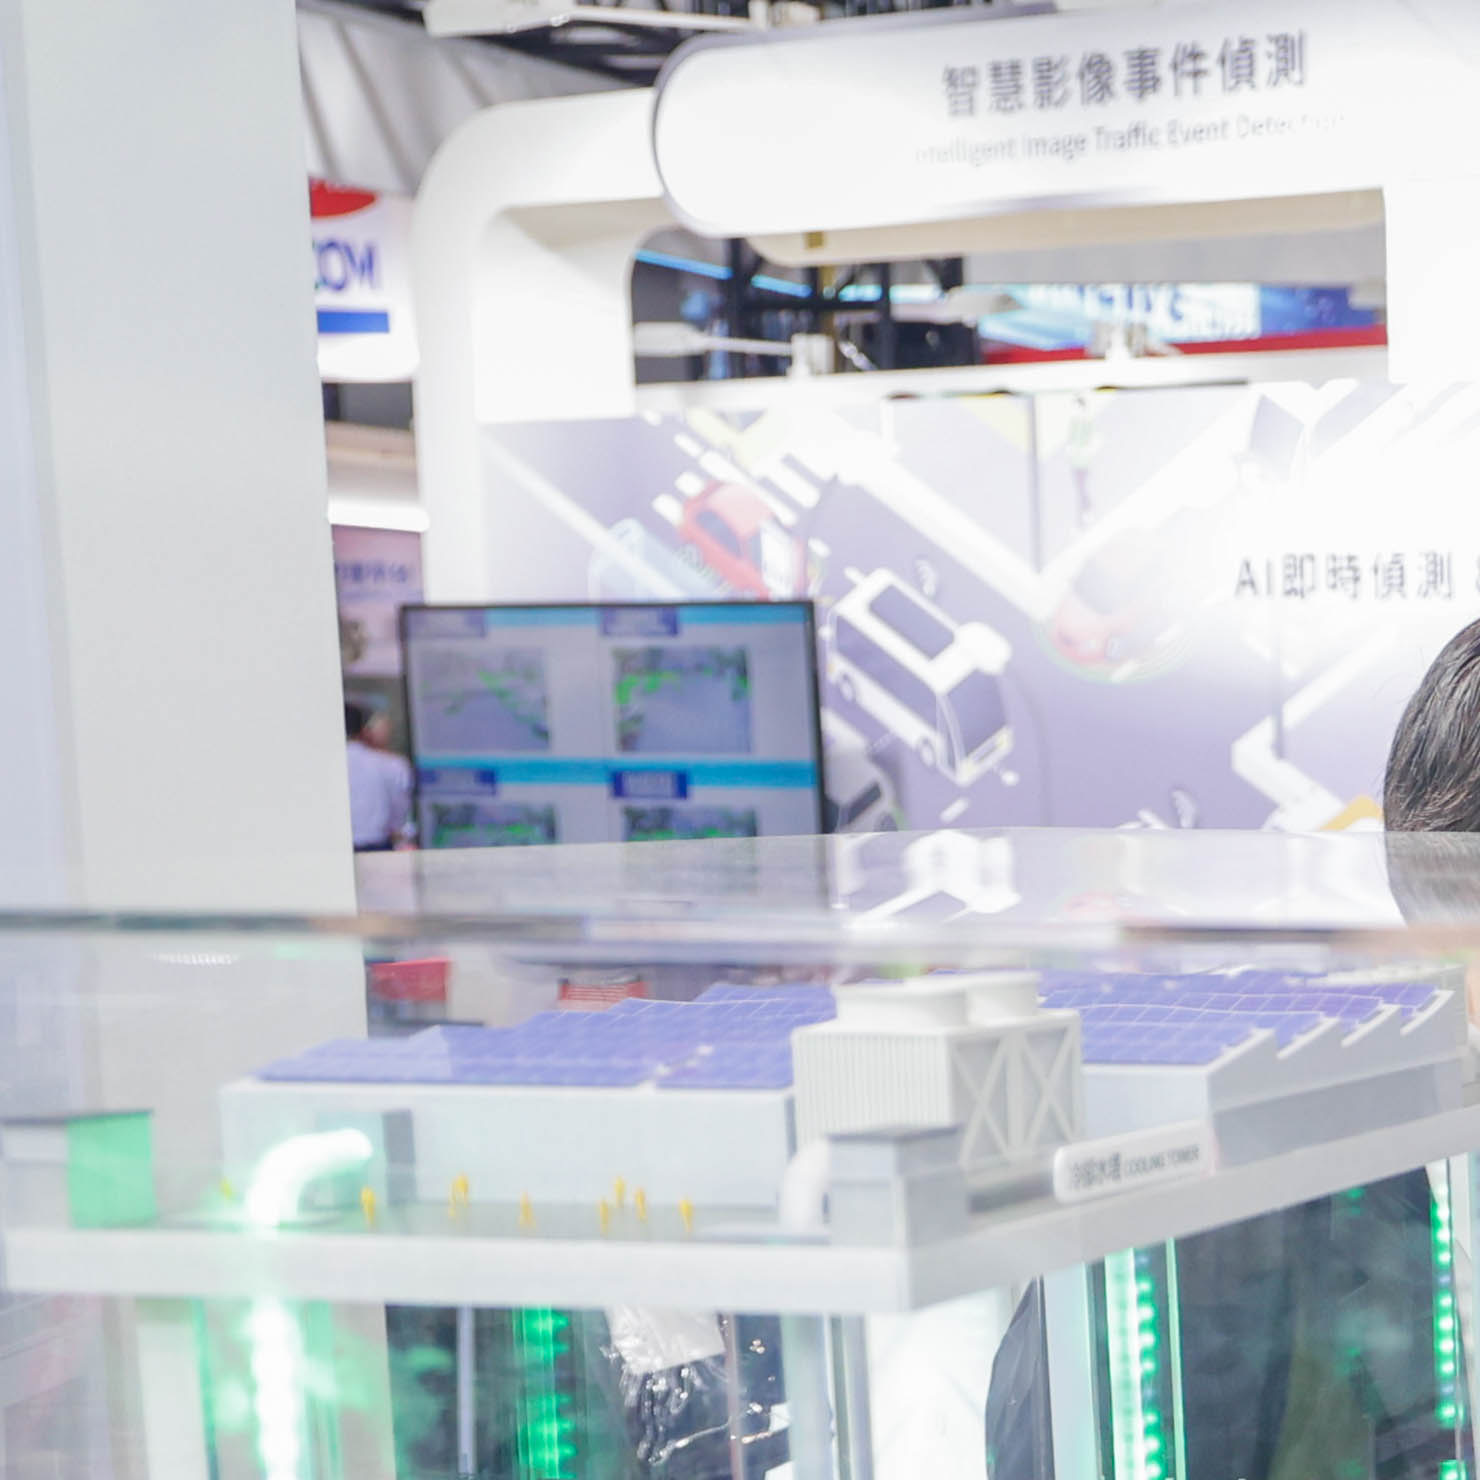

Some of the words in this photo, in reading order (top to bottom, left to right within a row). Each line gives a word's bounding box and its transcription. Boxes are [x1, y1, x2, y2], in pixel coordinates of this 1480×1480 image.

[942, 30, 1308, 118] 智慧影像事件偵測
[914, 136, 1017, 166] ntelligent
[1022, 132, 1086, 161] Image
[1094, 123, 1160, 152] Traffic
[1167, 119, 1229, 147] Event
[313, 239, 380, 291] OM
